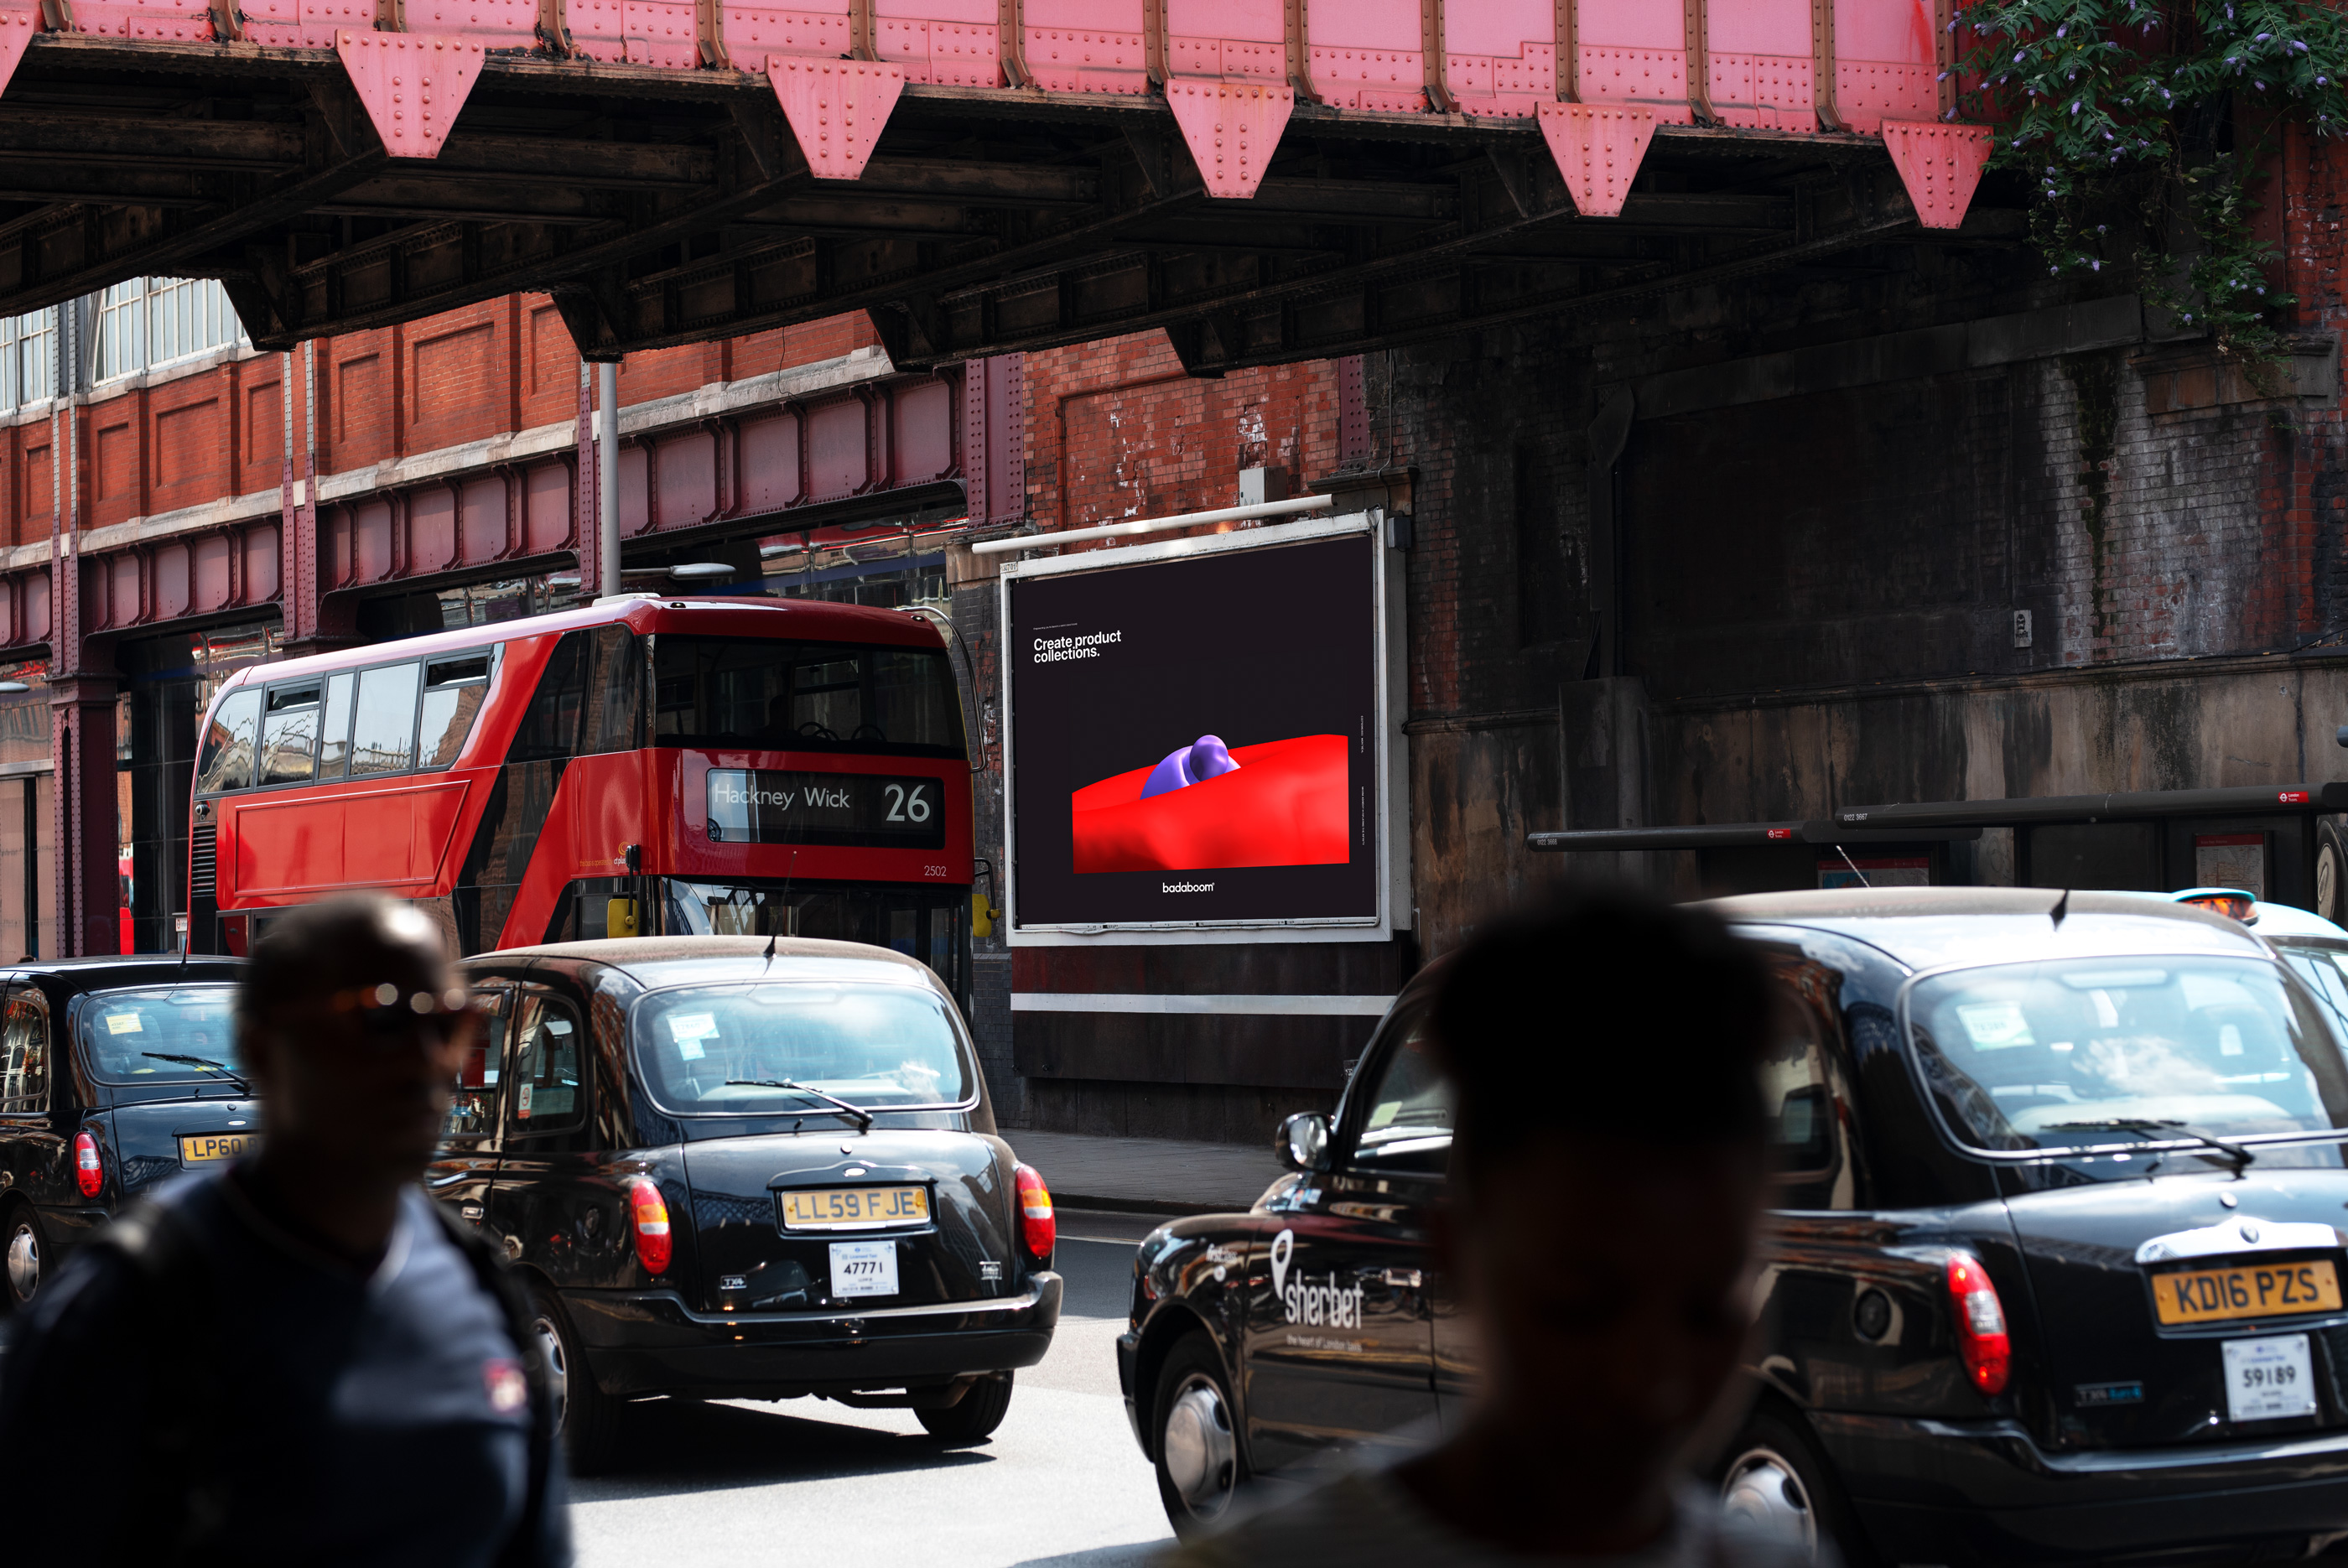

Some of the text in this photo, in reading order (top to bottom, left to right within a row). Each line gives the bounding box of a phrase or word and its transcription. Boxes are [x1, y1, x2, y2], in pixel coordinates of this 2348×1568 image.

[1033, 630, 1122, 652] Create product
[1033, 646, 1100, 663] collections.
[714, 783, 930, 823] Hackney Wick 26
[924, 865, 947, 877] 2502
[193, 1138, 242, 1157] LP60
[795, 1192, 916, 1219] LL59 FJE
[844, 1261, 883, 1275] 47771
[1285, 1268, 1364, 1330] sherbet
[2174, 1268, 2319, 1313] KD16 PZS
[2242, 1364, 2296, 1388] 59189
